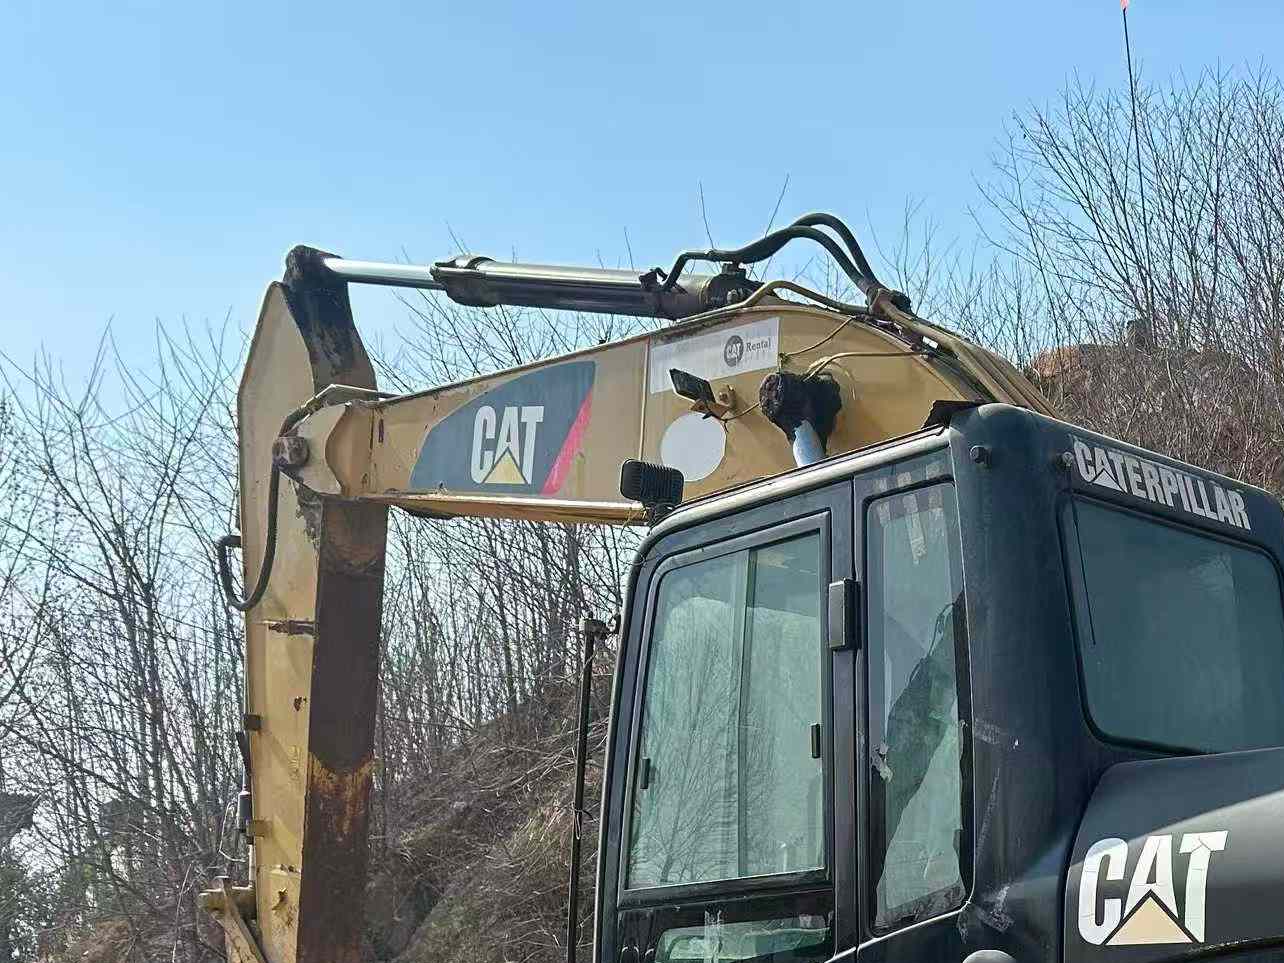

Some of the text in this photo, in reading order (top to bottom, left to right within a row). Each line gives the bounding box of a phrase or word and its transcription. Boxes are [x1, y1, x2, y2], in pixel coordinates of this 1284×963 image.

[745, 338, 771, 352] Rental
[470, 405, 544, 485] CAT
[1073, 440, 1250, 530] CATERPILLAR
[1078, 830, 1228, 945] CAT
